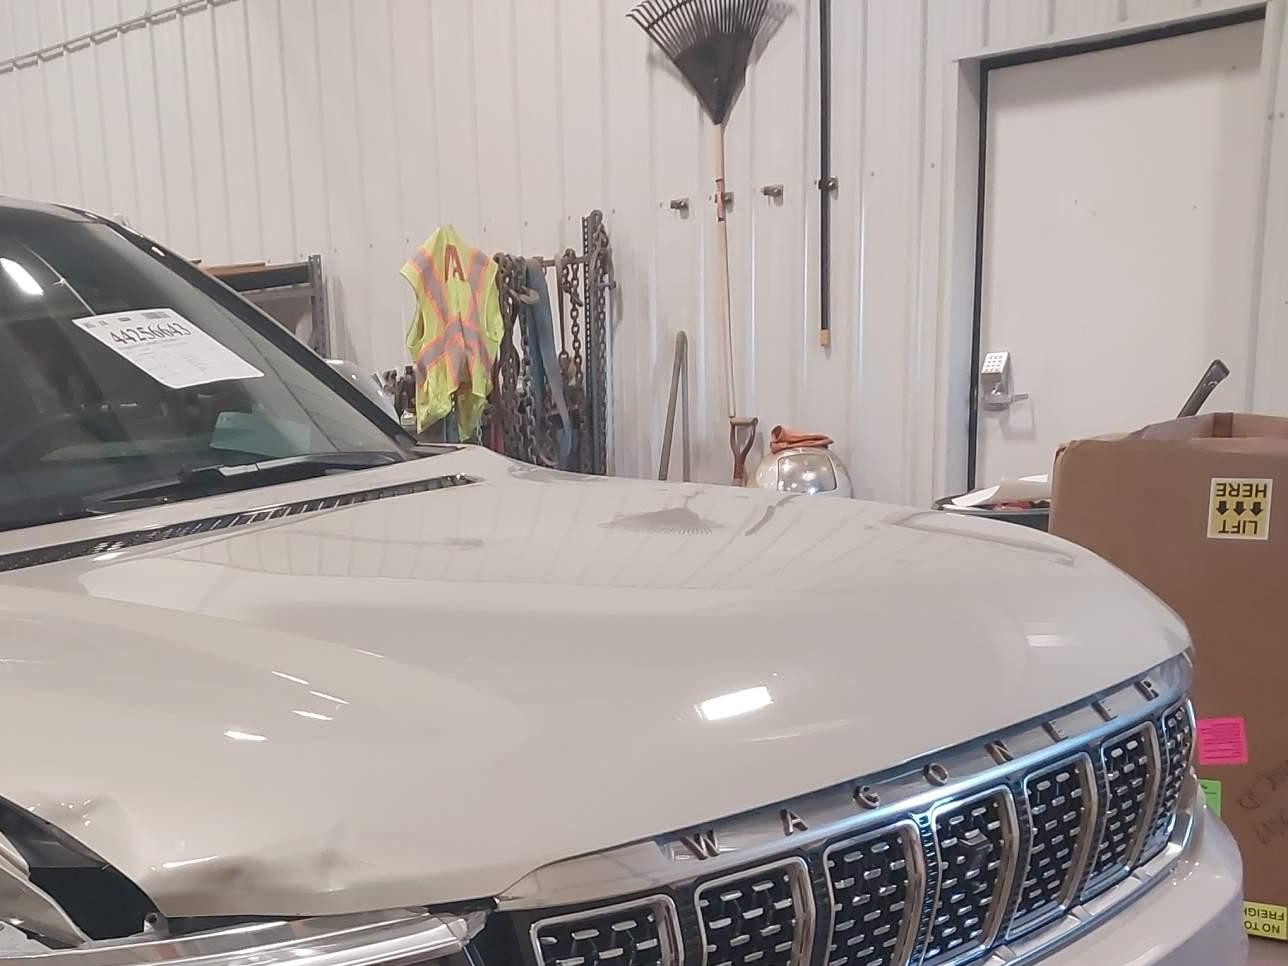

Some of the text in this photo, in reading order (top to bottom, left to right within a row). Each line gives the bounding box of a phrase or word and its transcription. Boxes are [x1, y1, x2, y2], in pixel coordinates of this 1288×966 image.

[443, 244, 465, 282] A
[109, 322, 192, 345] 44256643
[1215, 482, 1268, 498] HERE
[1218, 519, 1258, 535] LIFT
[679, 678, 1161, 861] WAGONEER
[1262, 923, 1280, 934] NO
